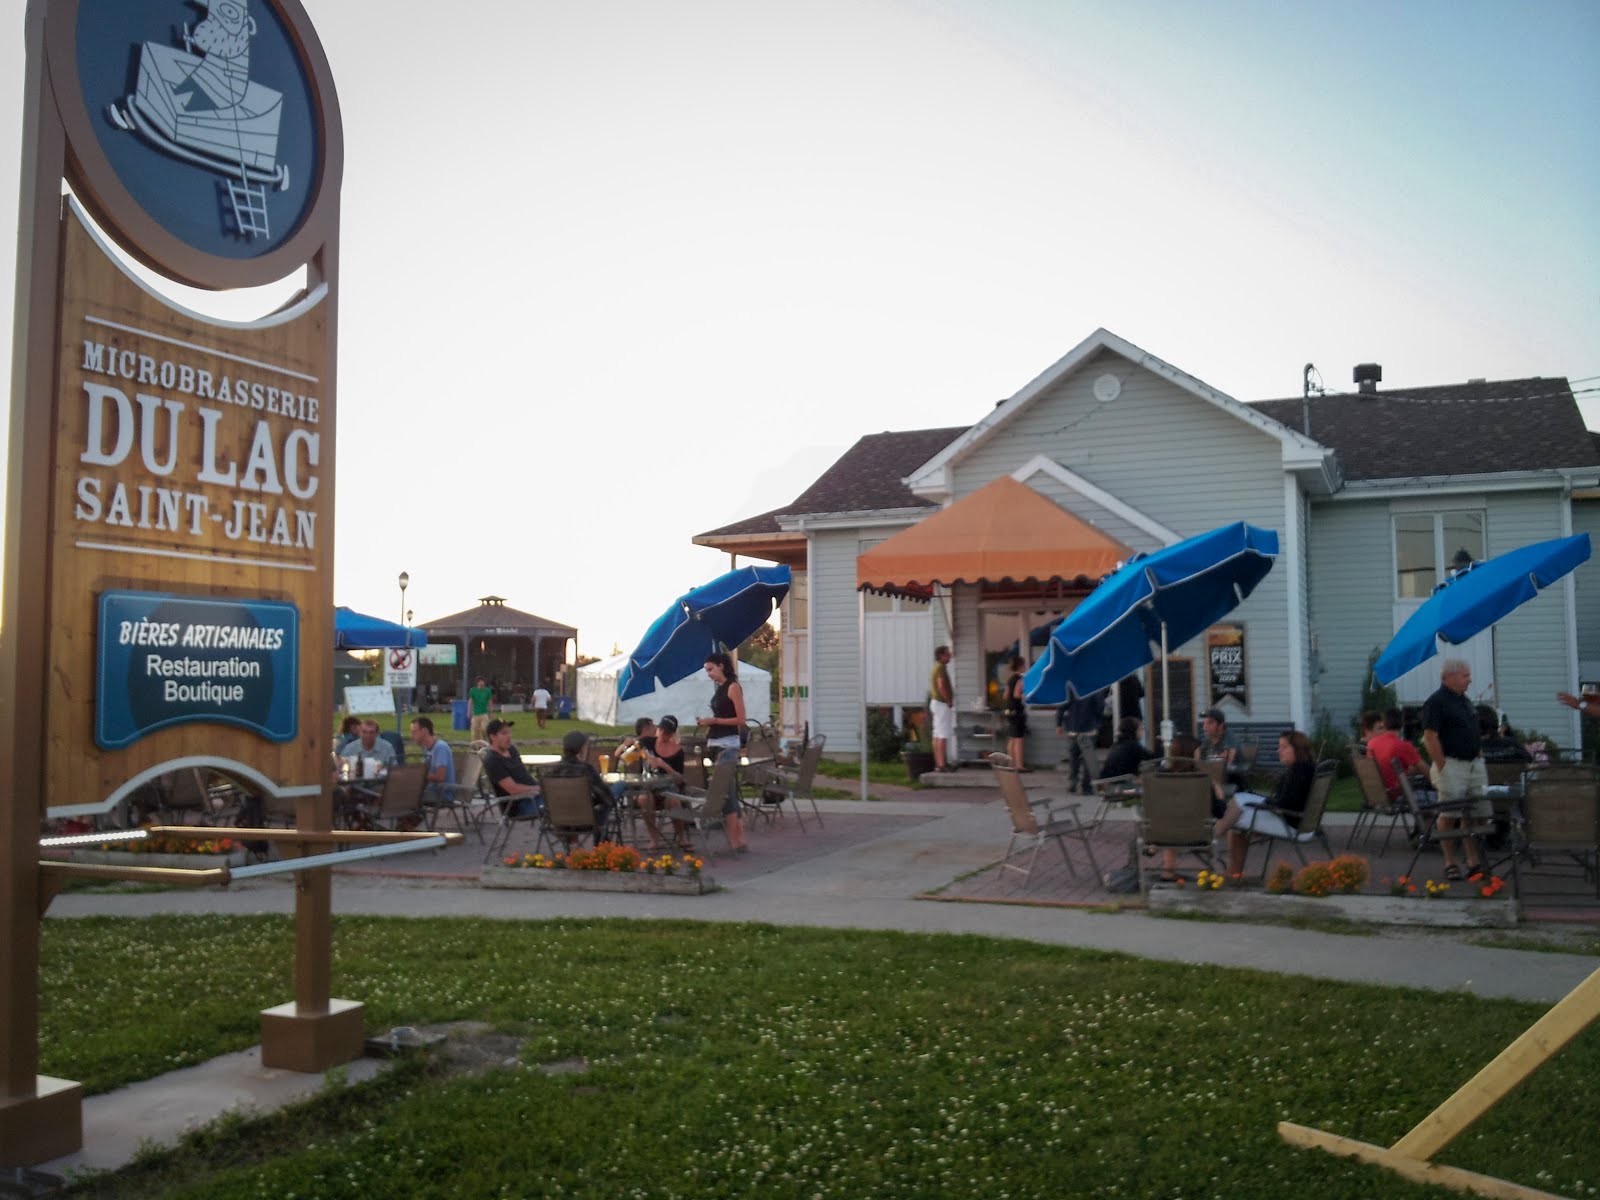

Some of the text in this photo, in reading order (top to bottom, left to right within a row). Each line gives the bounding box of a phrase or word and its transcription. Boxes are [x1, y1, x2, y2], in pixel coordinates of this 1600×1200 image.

[82, 340, 319, 424] MICROBRASSERIE
[80, 381, 320, 499] DU LAC
[76, 477, 317, 549] SAINT-JEAN
[119, 617, 284, 650] BIÈRES ARTISANALES
[146, 654, 260, 678] Restauration
[1211, 650, 1242, 664] PRIX
[164, 680, 243, 705] Boutique
